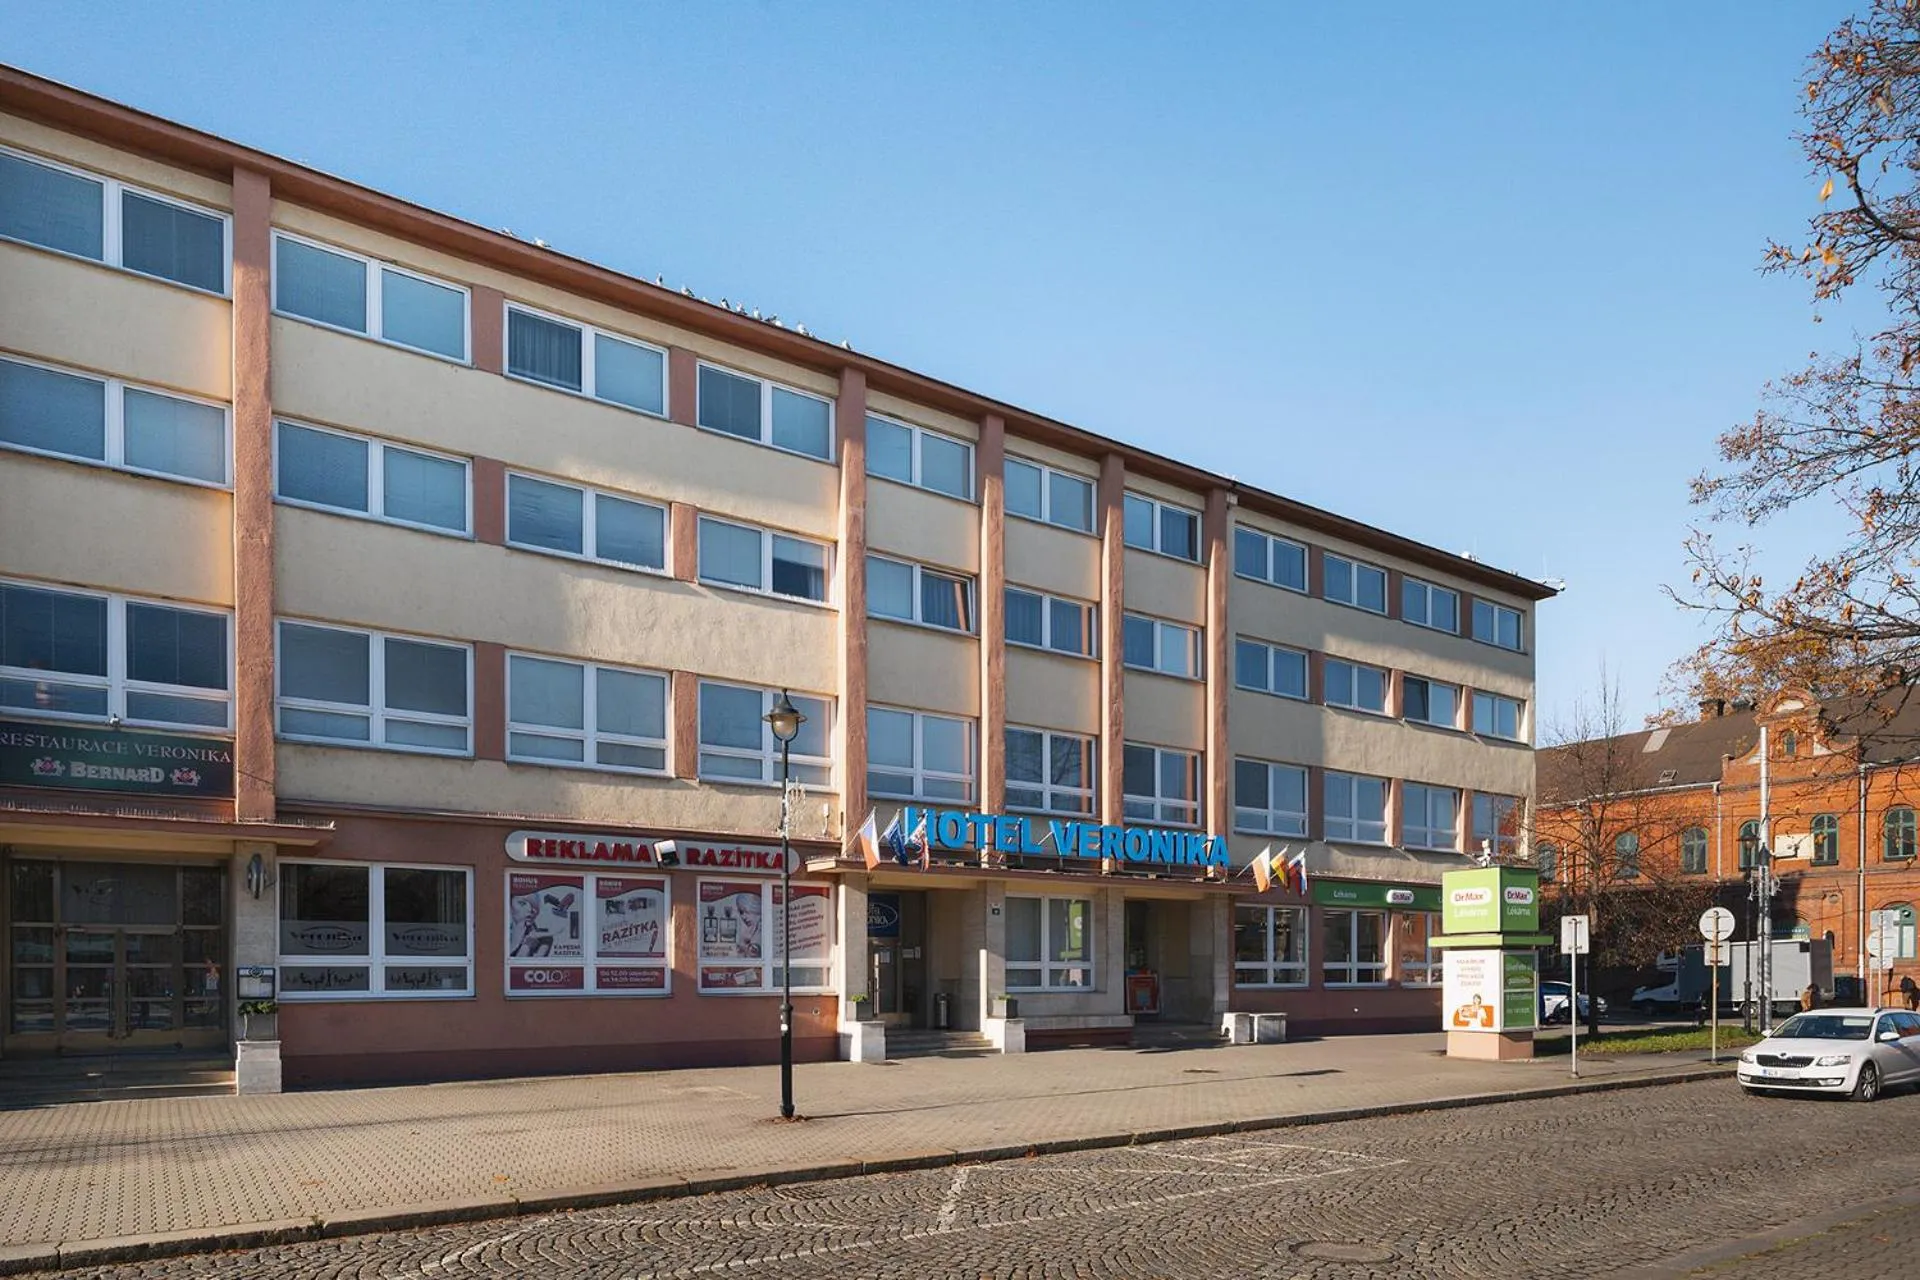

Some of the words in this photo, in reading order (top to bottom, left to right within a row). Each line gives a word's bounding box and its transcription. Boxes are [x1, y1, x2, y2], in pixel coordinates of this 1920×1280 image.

[0, 731, 129, 755] RESTAURACE
[134, 743, 232, 763] VERONIKA
[70, 761, 165, 783] BERNARD
[904, 806, 1043, 855] HOTEL
[1049, 819, 1230, 867] VERONIKA
[524, 837, 652, 863] REKLAMA
[686, 846, 784, 869] RAZÍTKA
[602, 919, 658, 944] RAZÍTKA
